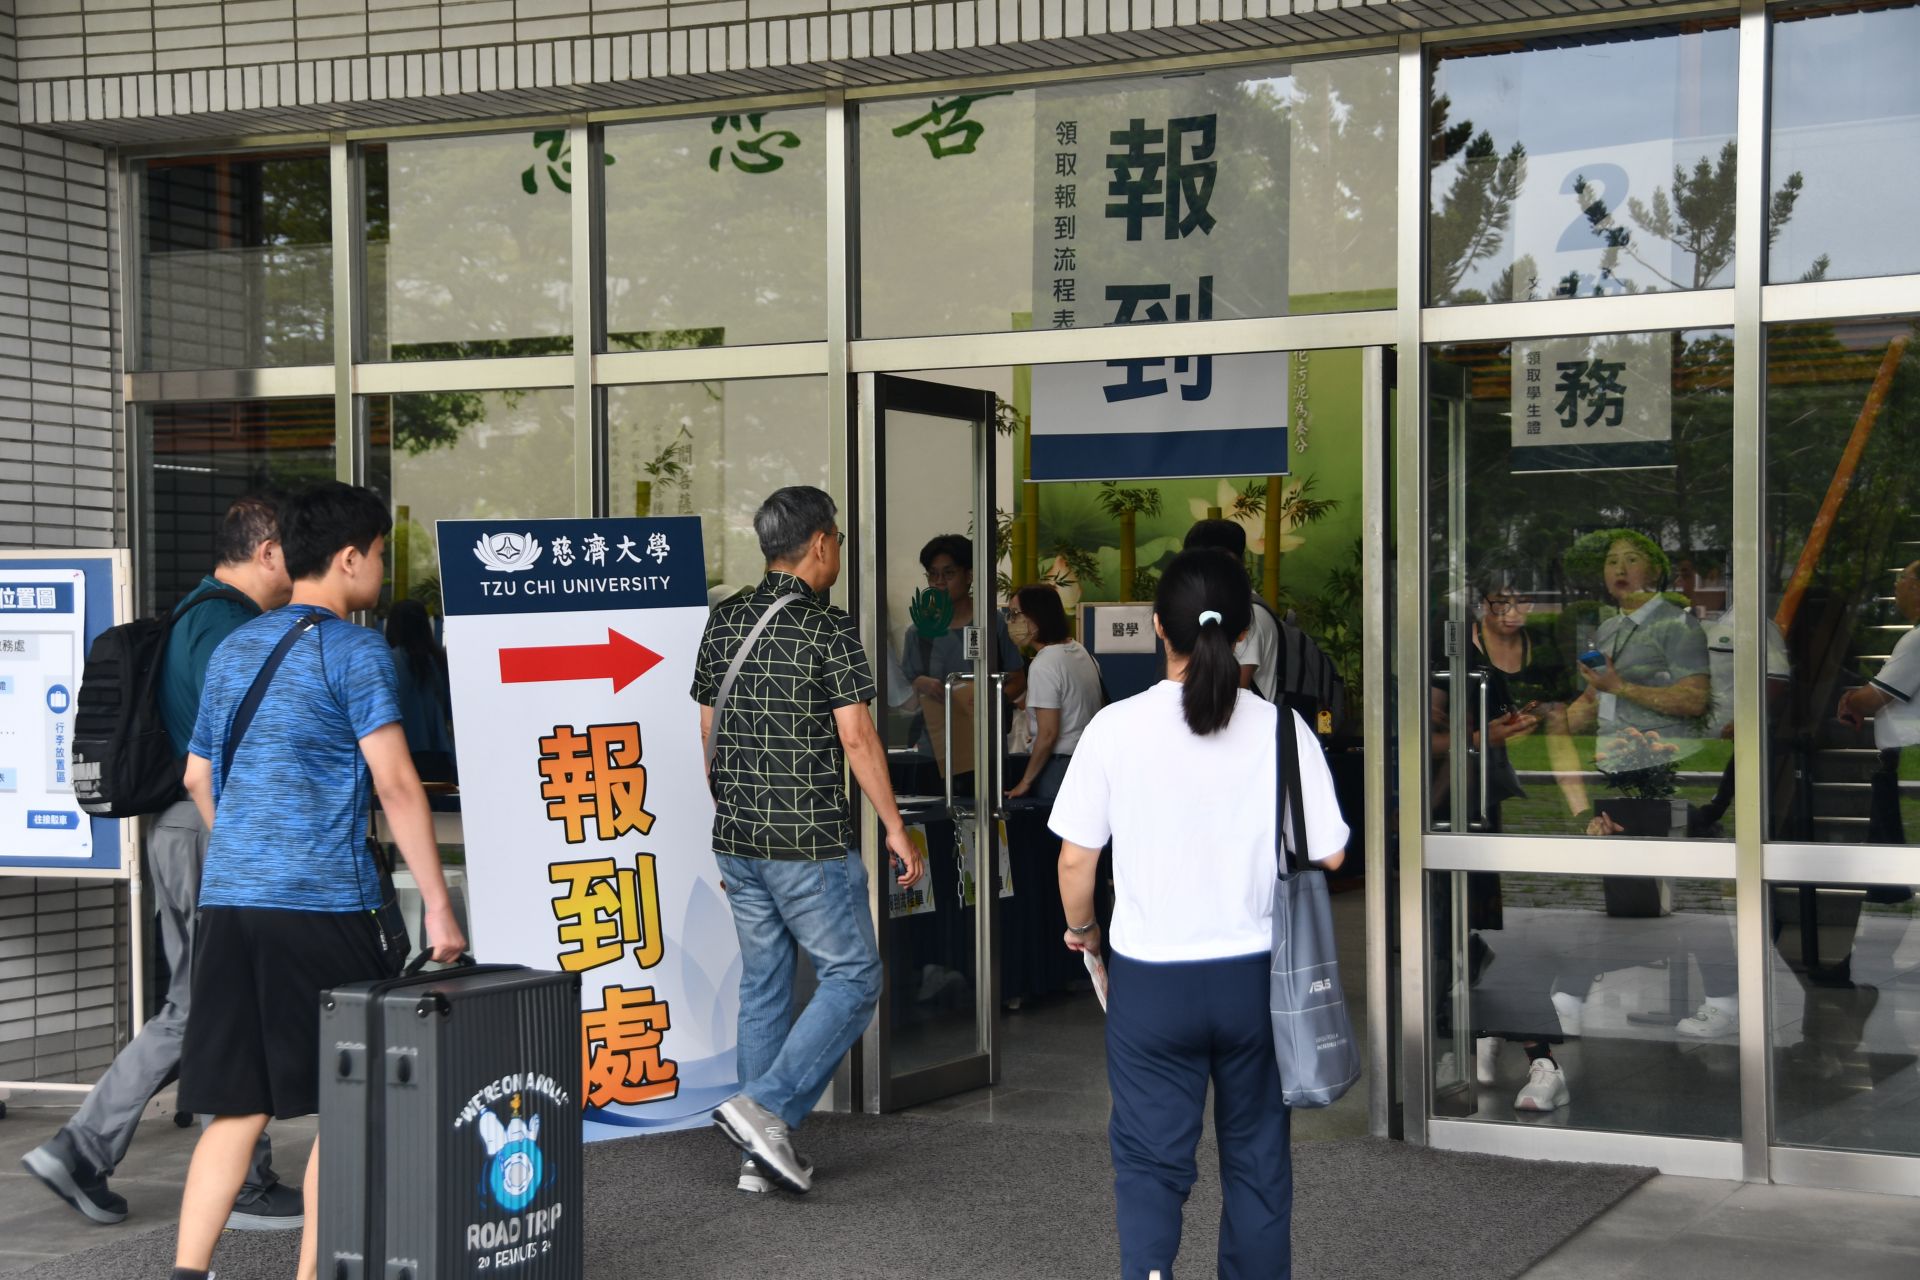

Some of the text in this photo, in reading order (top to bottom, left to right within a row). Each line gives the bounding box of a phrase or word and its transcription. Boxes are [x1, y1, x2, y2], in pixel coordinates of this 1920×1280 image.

[1052, 119, 1078, 329] 領取報到流程表
[1556, 163, 1630, 253] 2
[1102, 112, 1219, 404] 報到
[1526, 351, 1542, 435] 領取學生證
[551, 532, 671, 567] 慈濟大學
[0, 587, 57, 609] 位置圖
[480, 575, 671, 596] TZU CHI UNIVERSITY
[1112, 622, 1139, 637] 醫學
[537, 721, 680, 1109] 報到處
[502, 1073, 523, 1095] ON
[526, 1071, 536, 1091] A
[467, 1202, 563, 1252] ROAD TRIP
[478, 1255, 491, 1269] 20
[495, 1241, 538, 1268] PEANUTS
